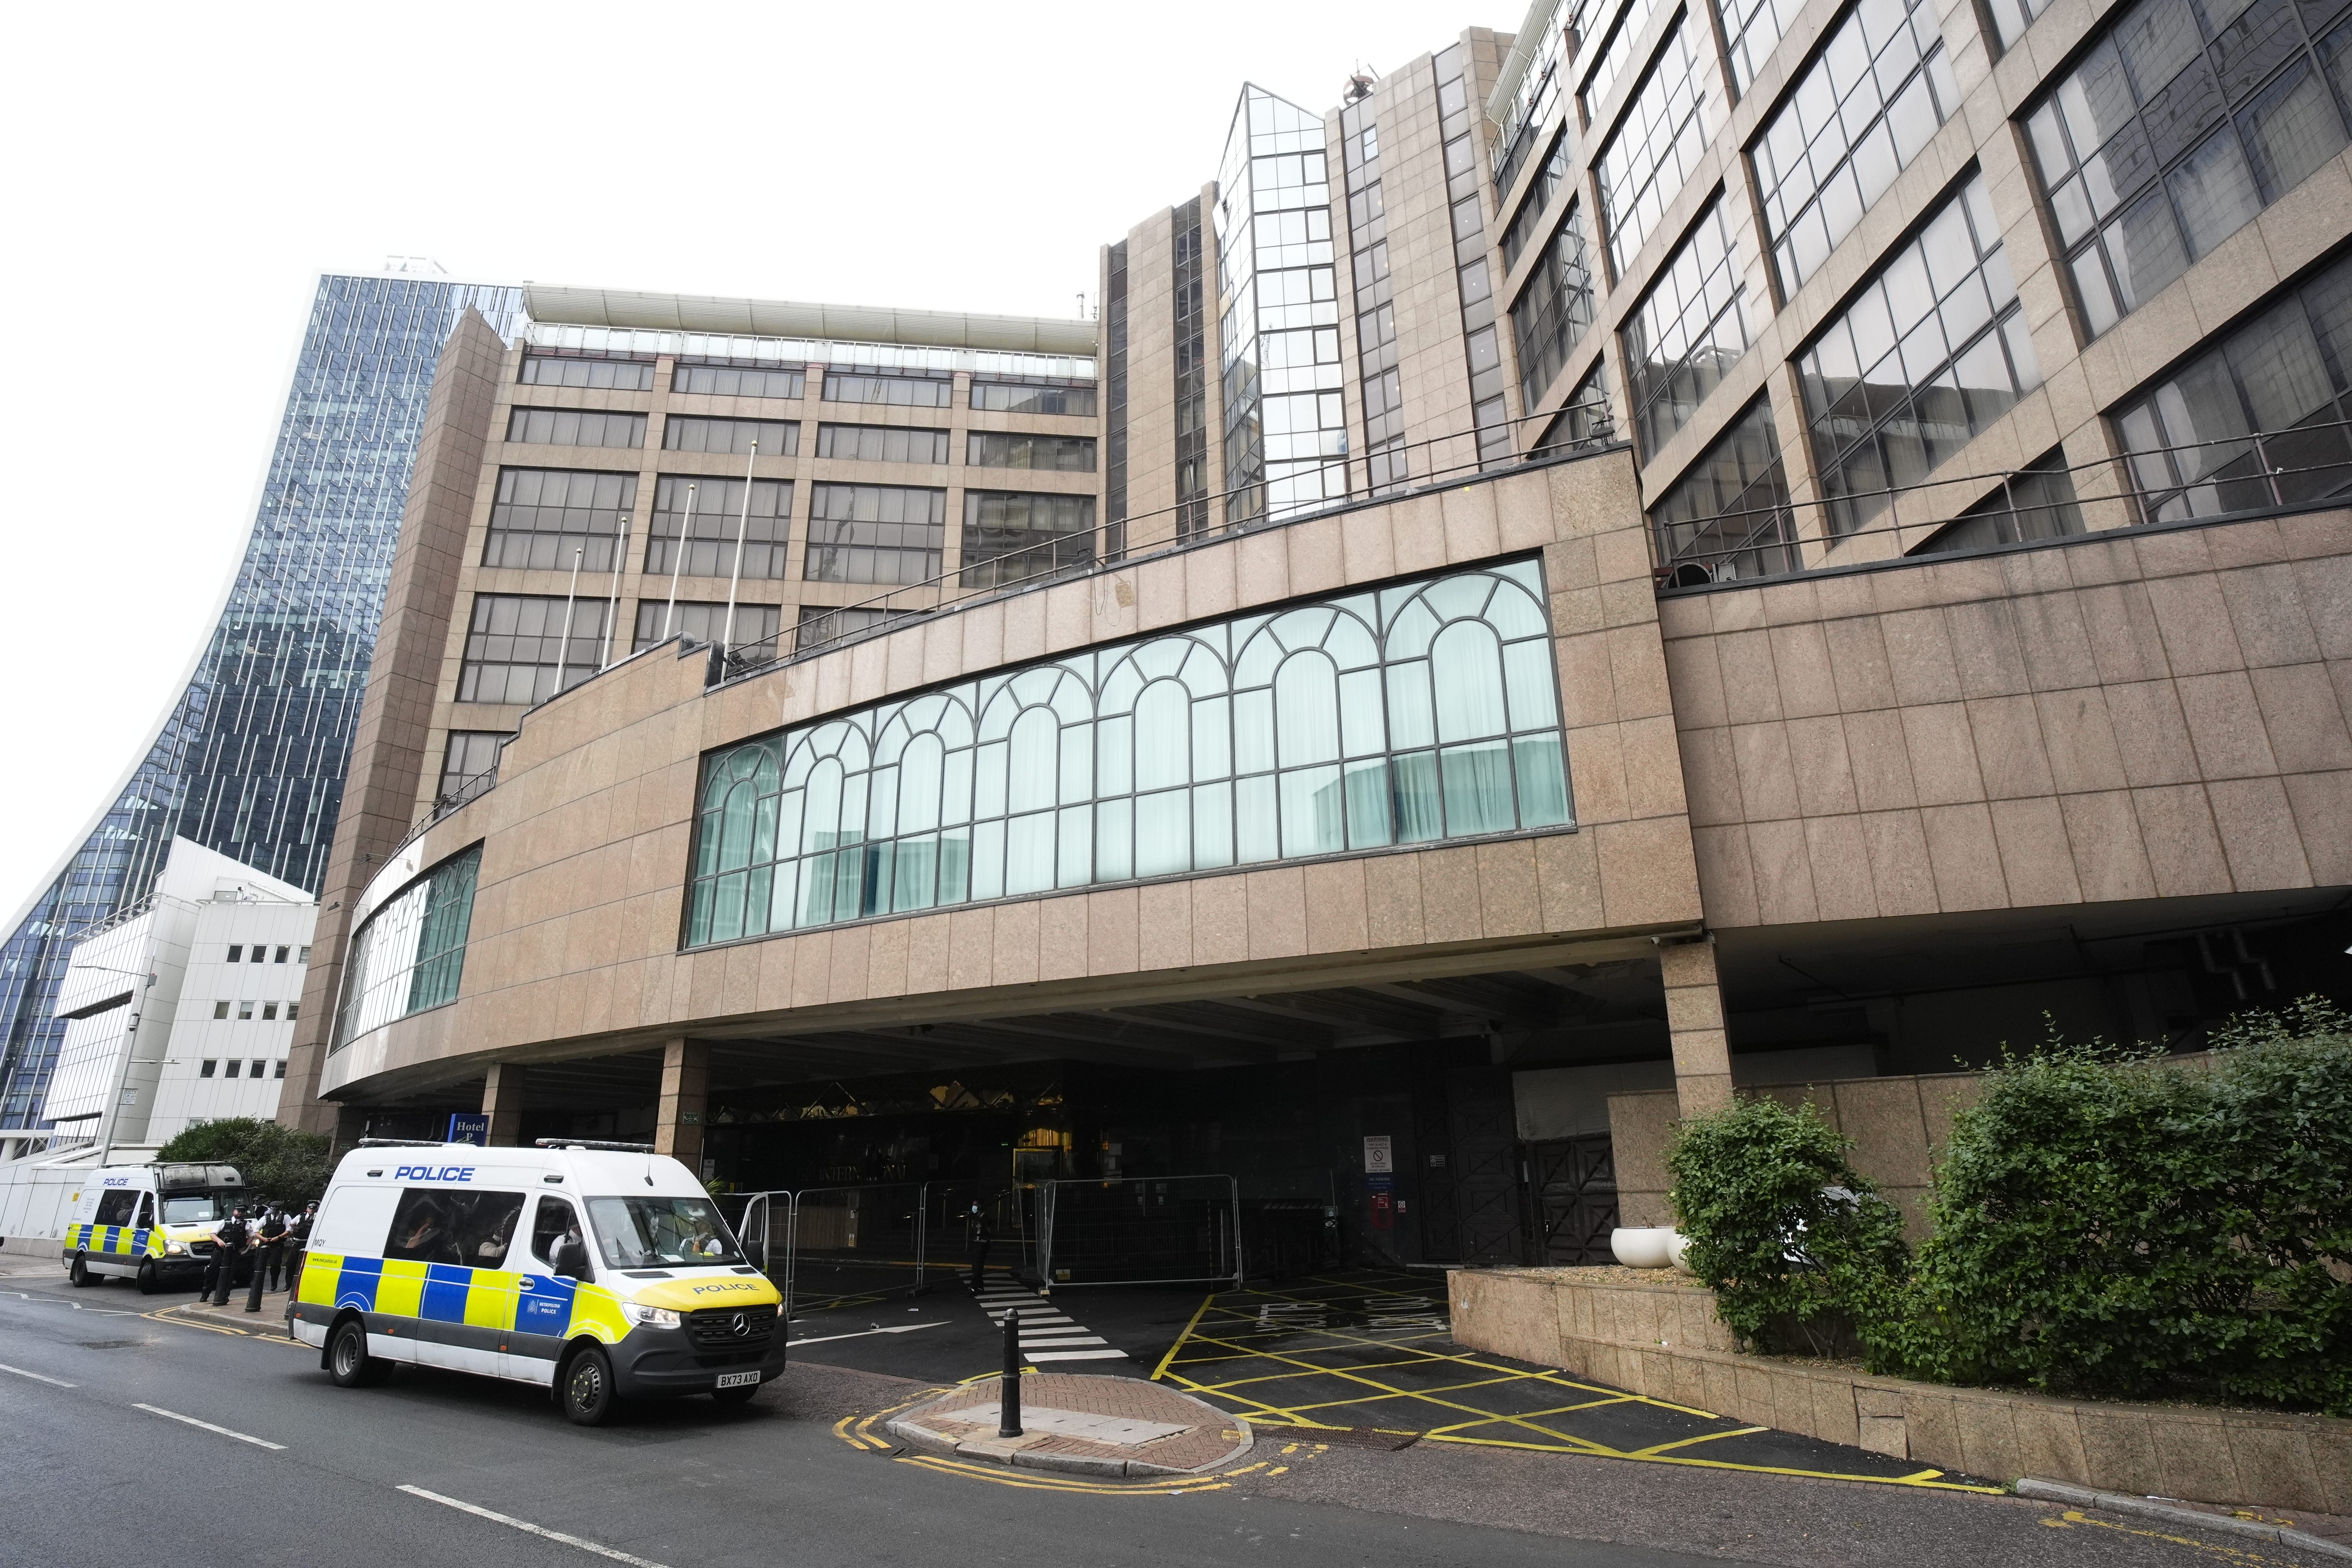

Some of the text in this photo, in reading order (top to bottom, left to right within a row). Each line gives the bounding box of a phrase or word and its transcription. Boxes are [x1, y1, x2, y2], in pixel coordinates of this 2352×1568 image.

[457, 1122, 485, 1131] Hotel
[394, 1166, 475, 1181] POLICE
[692, 1284, 760, 1294] POLICE
[720, 1372, 758, 1386] BX73 AXO
